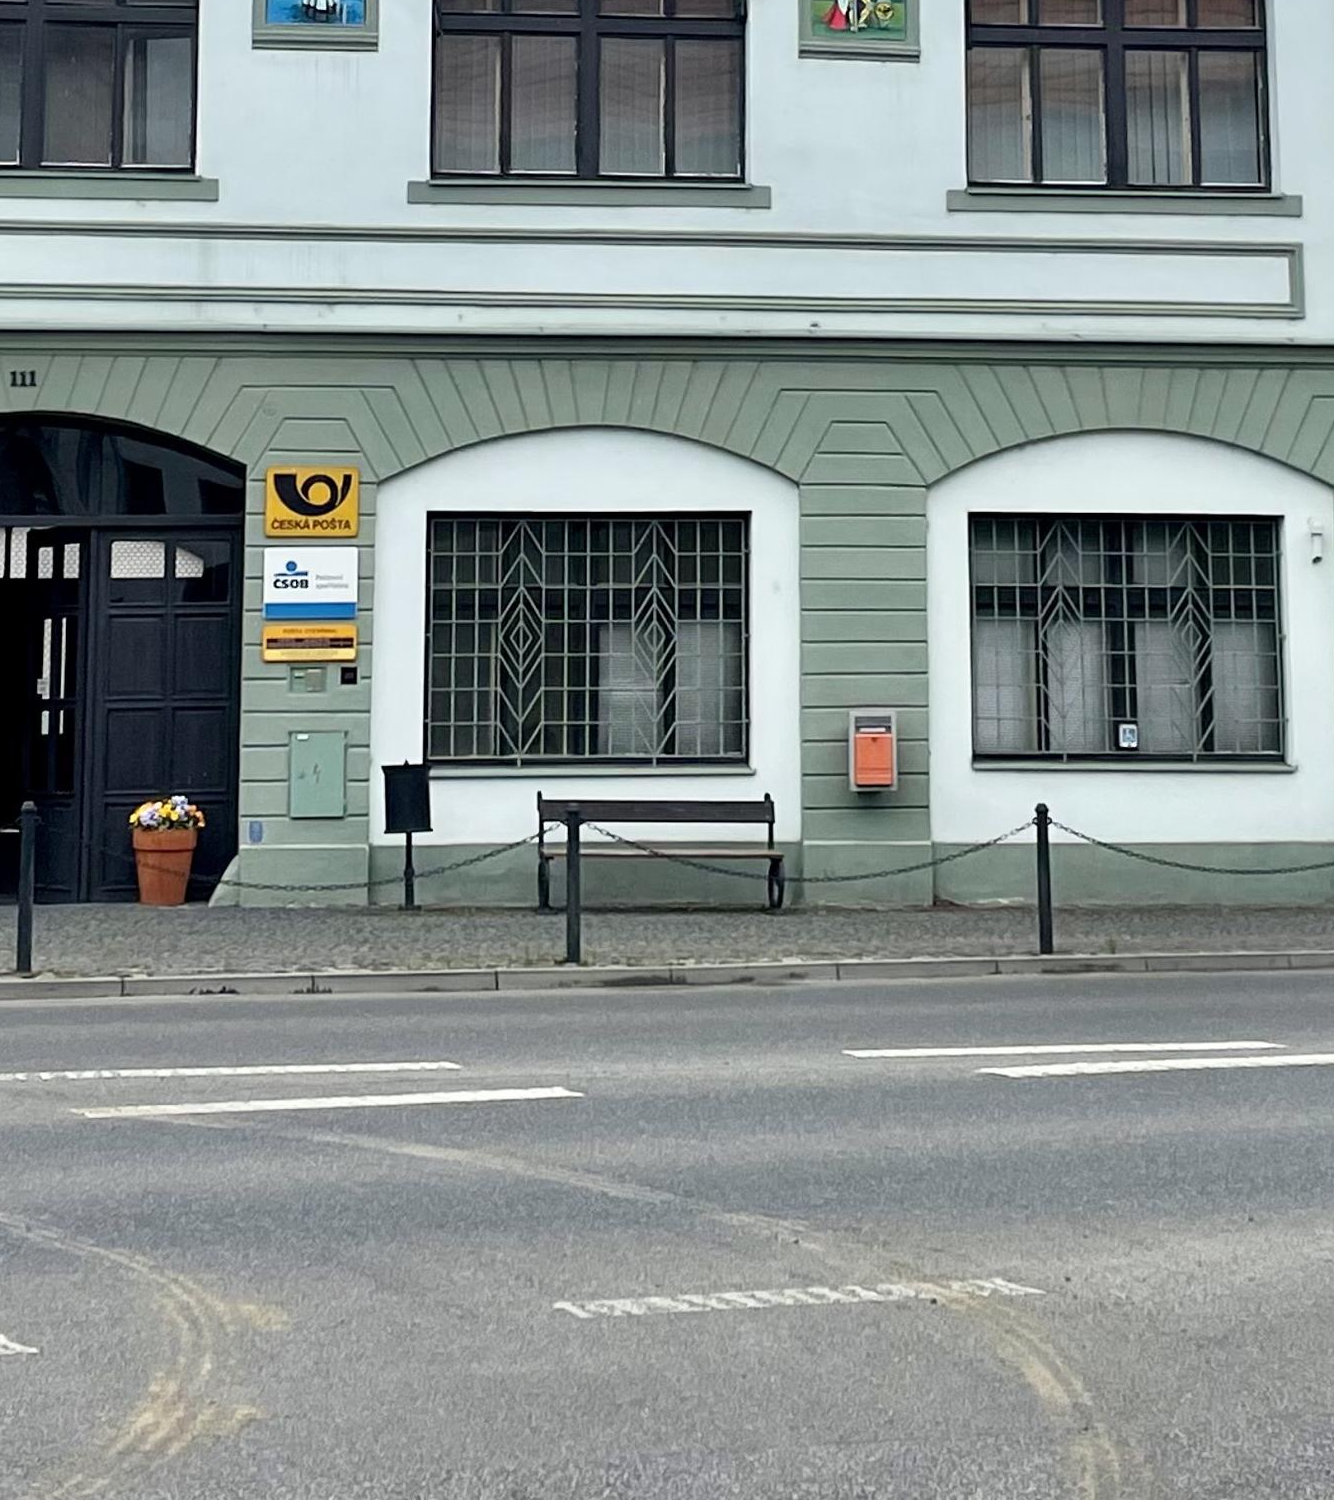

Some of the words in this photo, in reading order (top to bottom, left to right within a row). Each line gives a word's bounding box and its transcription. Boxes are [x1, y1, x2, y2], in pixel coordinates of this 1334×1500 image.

[10, 370, 37, 387] 111
[271, 516, 310, 530] ČESKÁ
[312, 517, 352, 530] POŠTA
